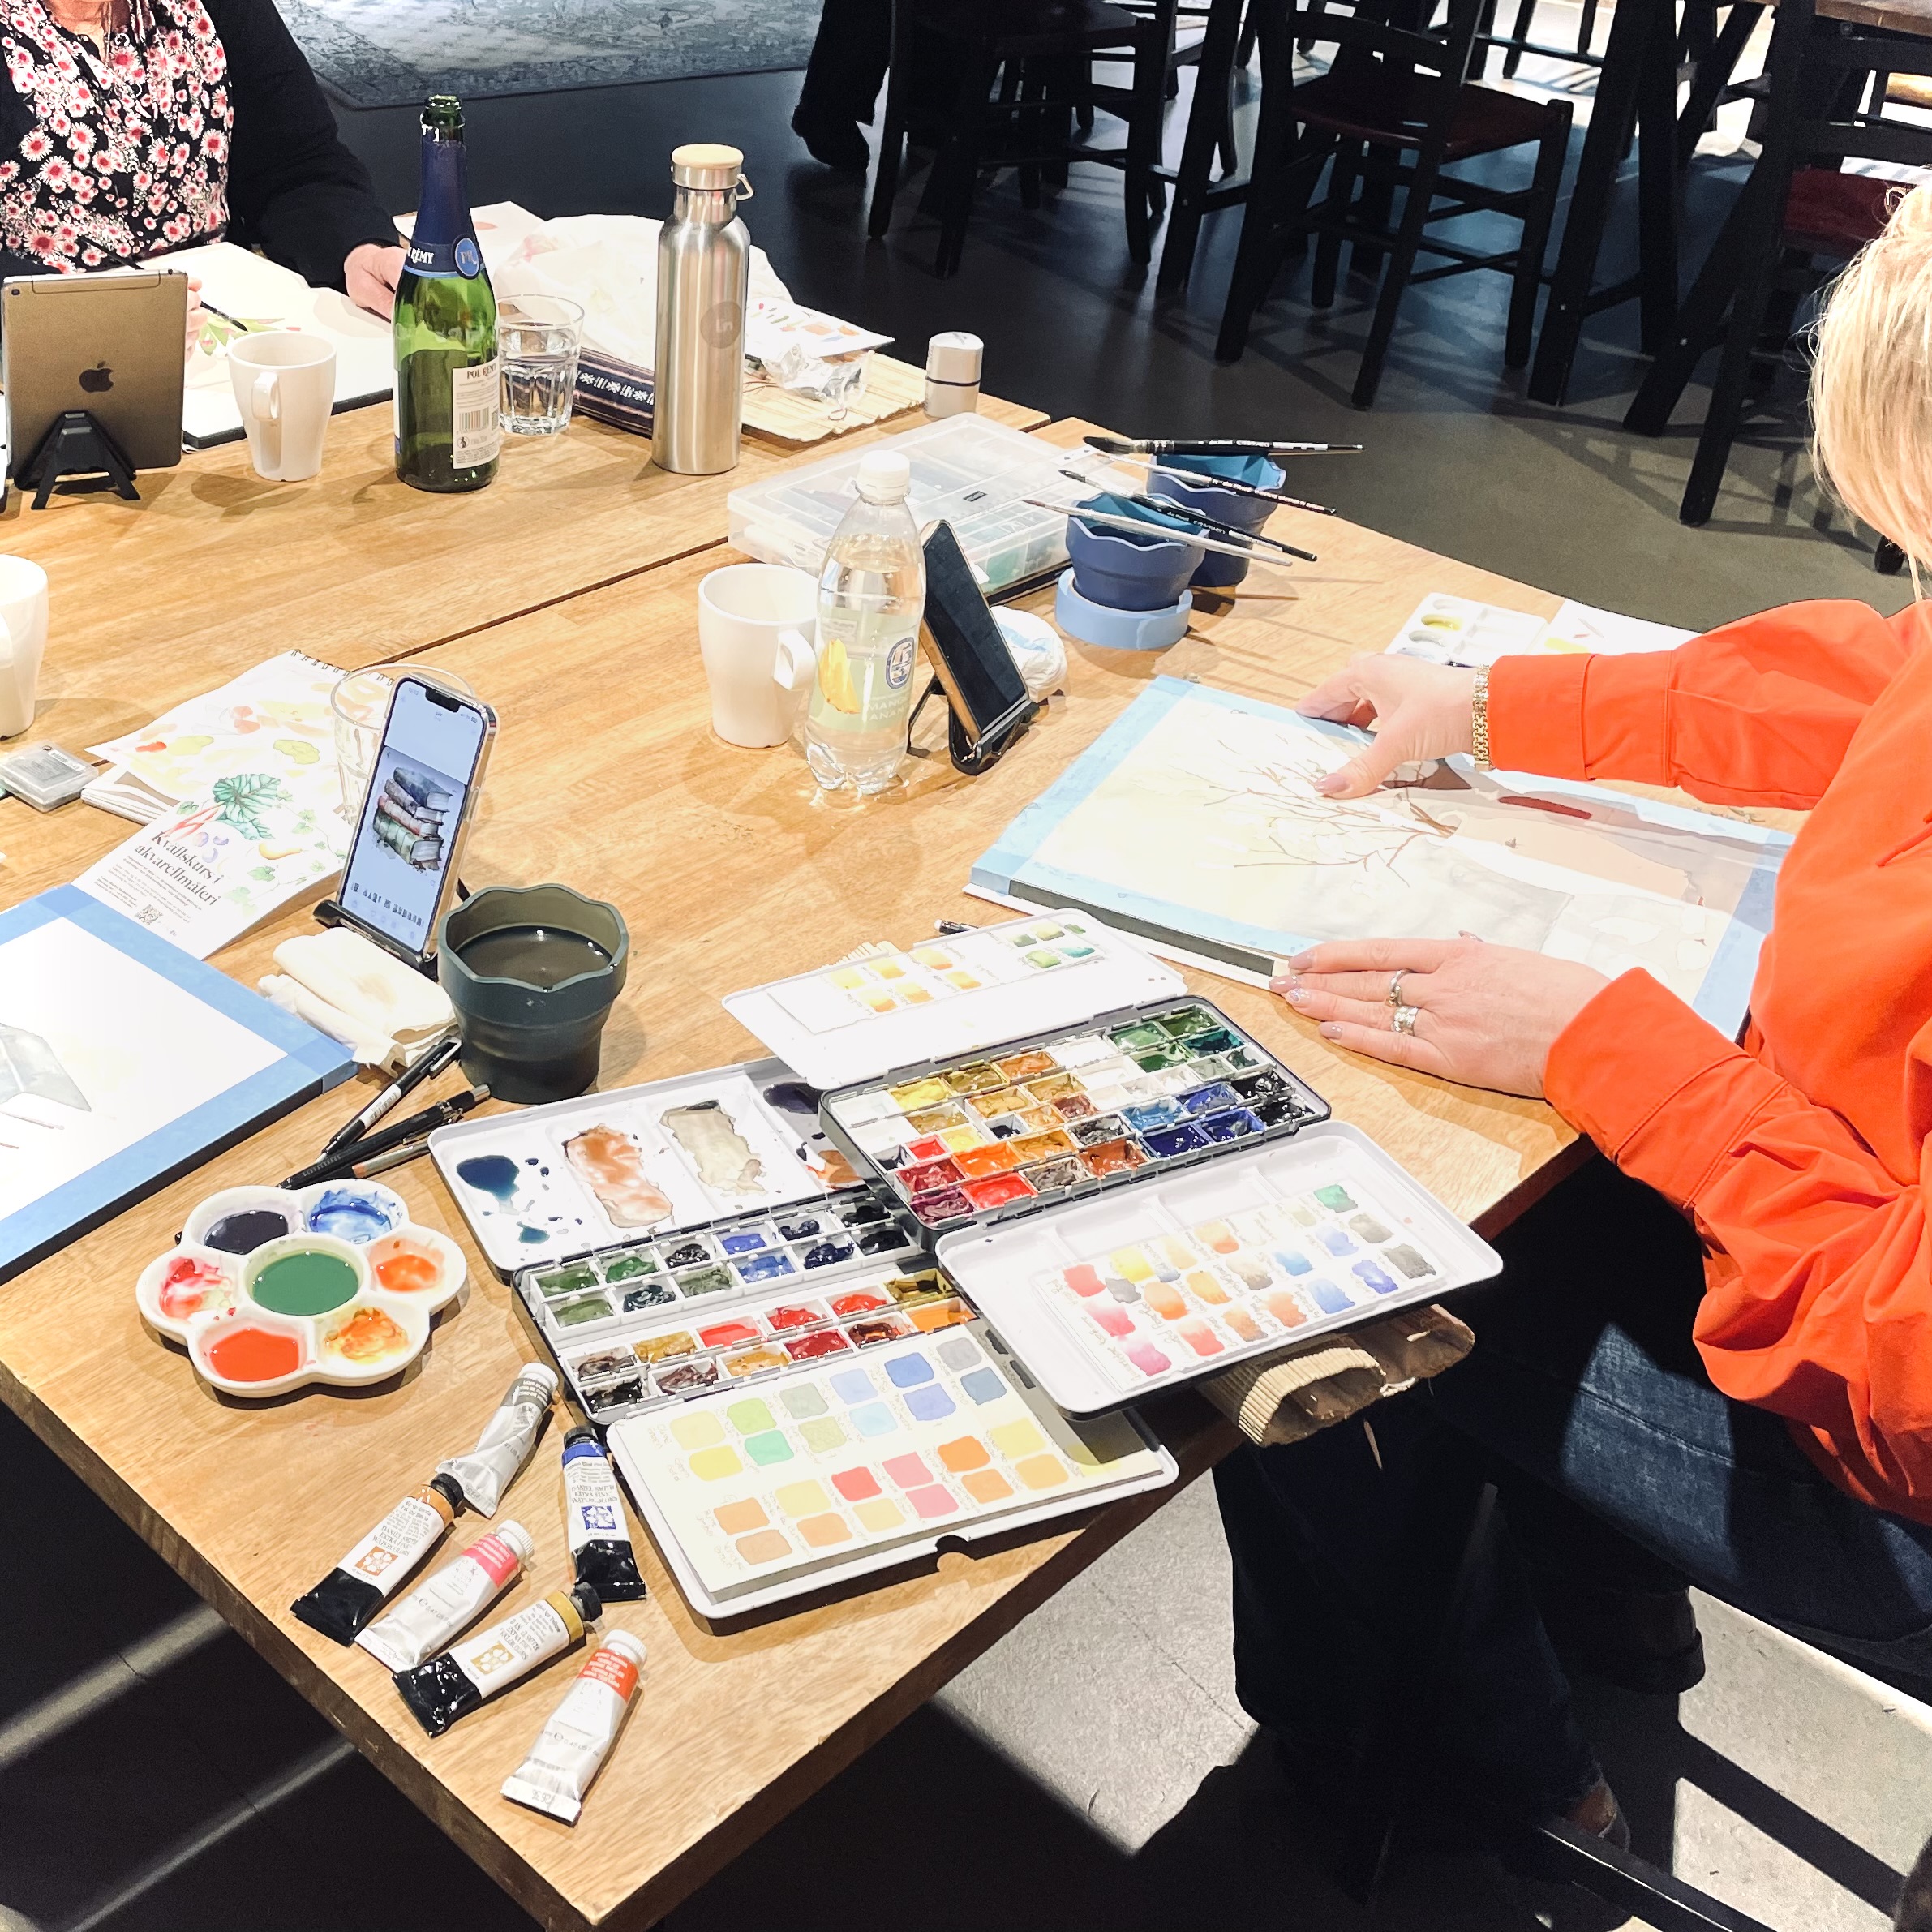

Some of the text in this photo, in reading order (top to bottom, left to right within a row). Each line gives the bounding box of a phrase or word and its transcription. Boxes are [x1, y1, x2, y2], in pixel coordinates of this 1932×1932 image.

[467, 369, 481, 380] POL
[151, 831, 215, 880] Kvällskurs
[212, 875, 225, 885] i
[134, 844, 221, 906] akvarellmåleri
[379, 1532, 397, 1545] EXTRA
[382, 1525, 418, 1546] DANIEL SMITH
